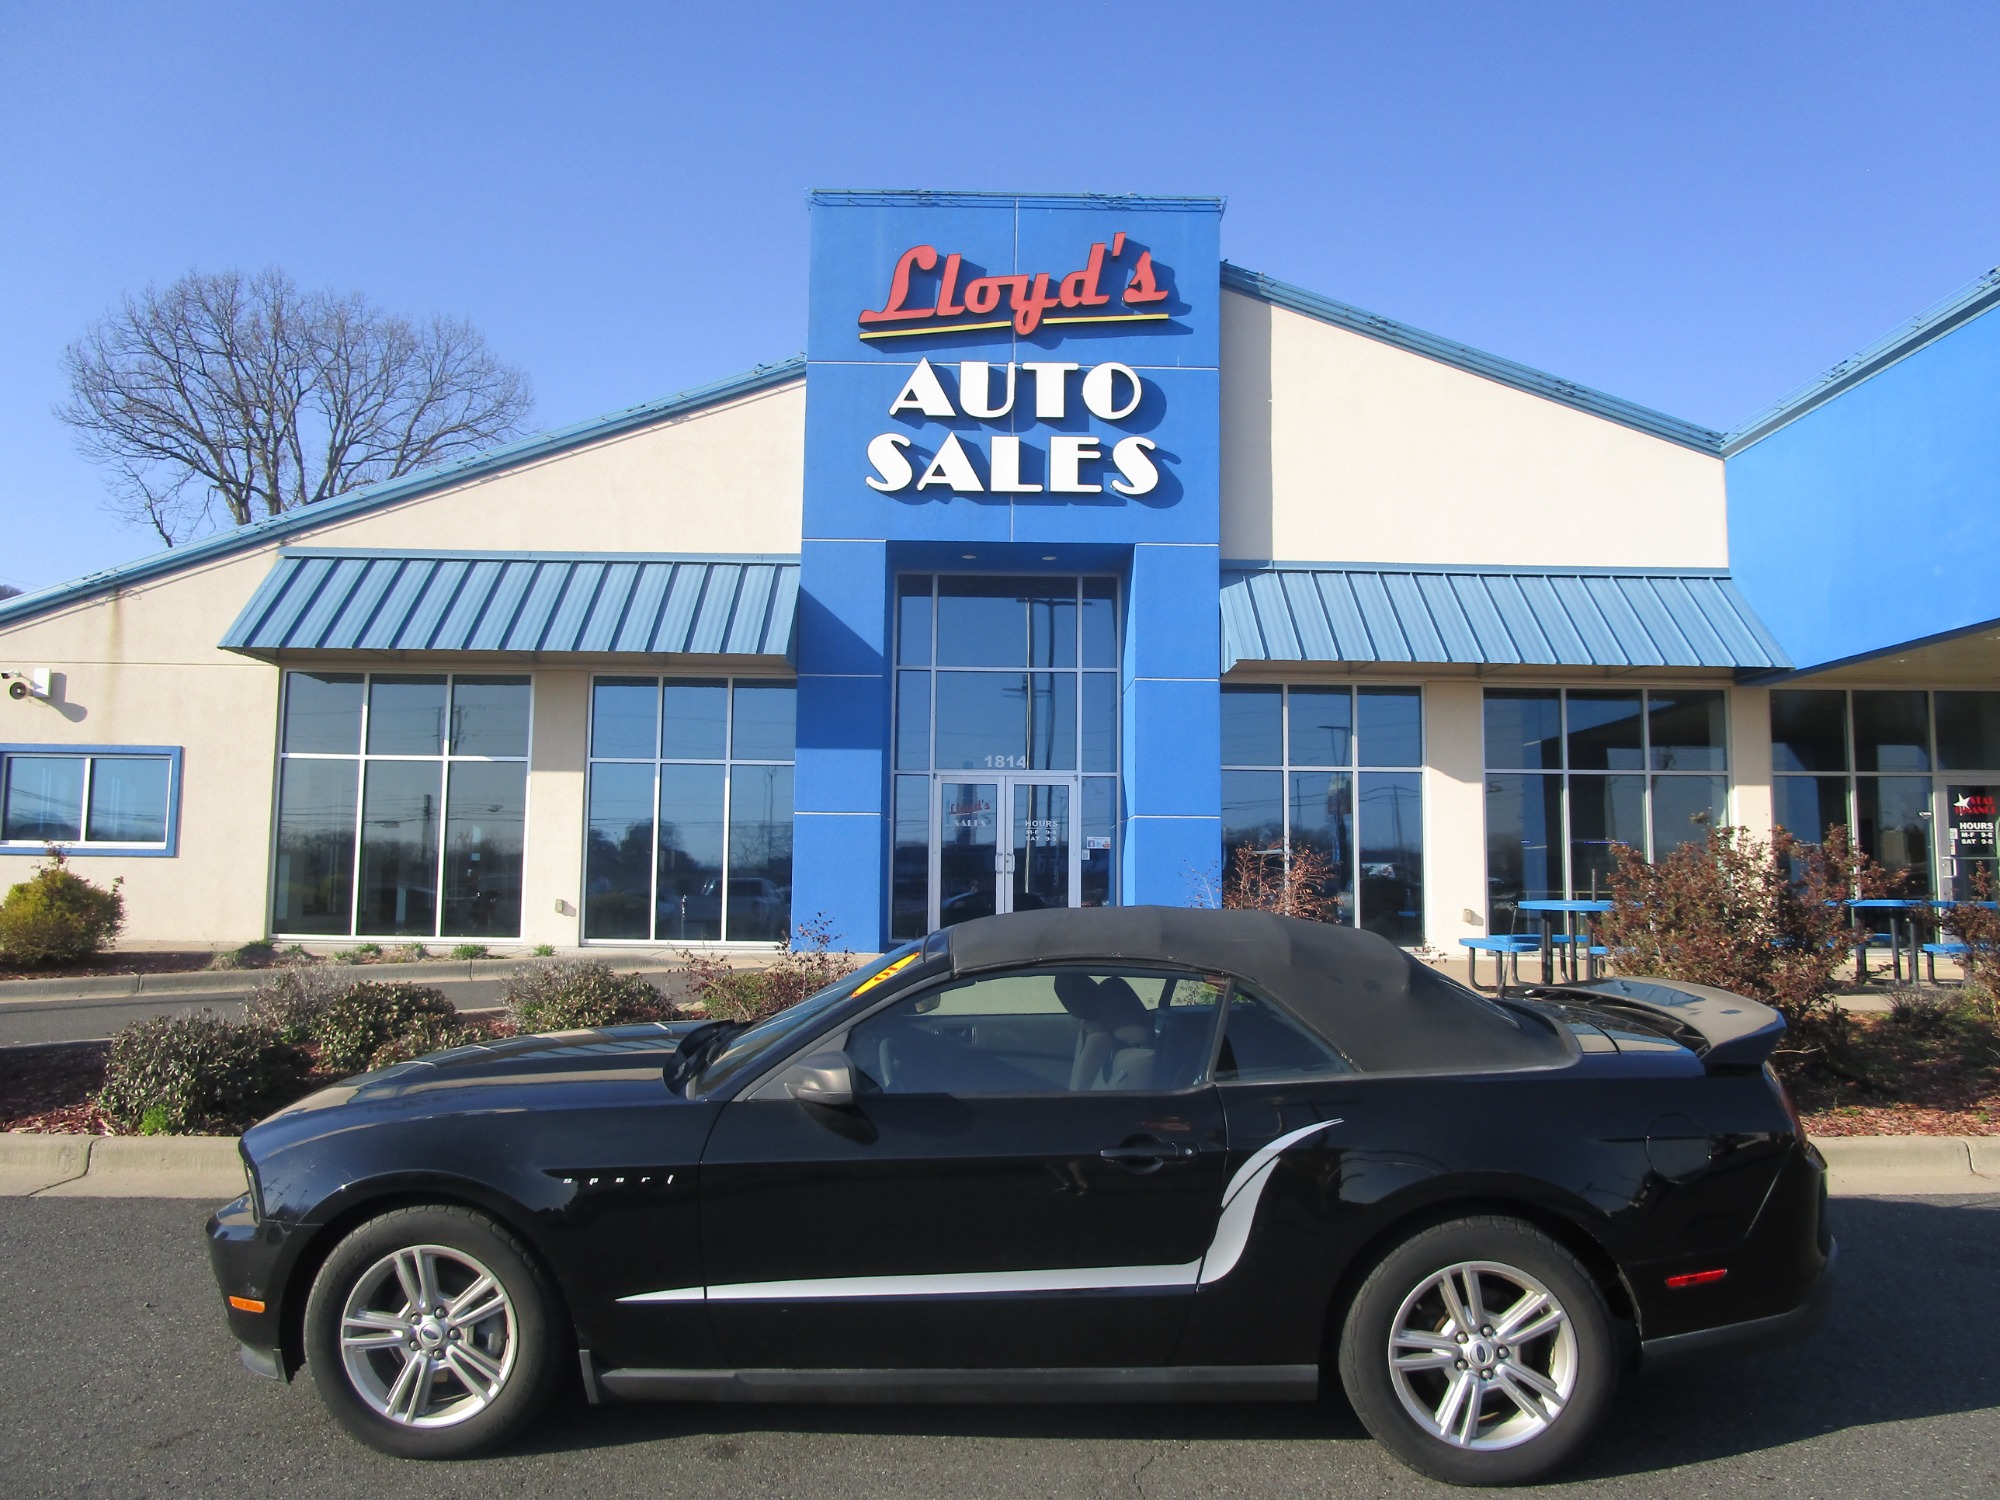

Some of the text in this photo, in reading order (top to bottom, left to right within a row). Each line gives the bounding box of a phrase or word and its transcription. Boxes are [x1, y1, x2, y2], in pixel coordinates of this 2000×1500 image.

[858, 232, 1169, 335] Lloyd's
[888, 356, 1142, 420] AUTO
[865, 431, 1160, 495] SALES
[984, 754, 1027, 768] 1814
